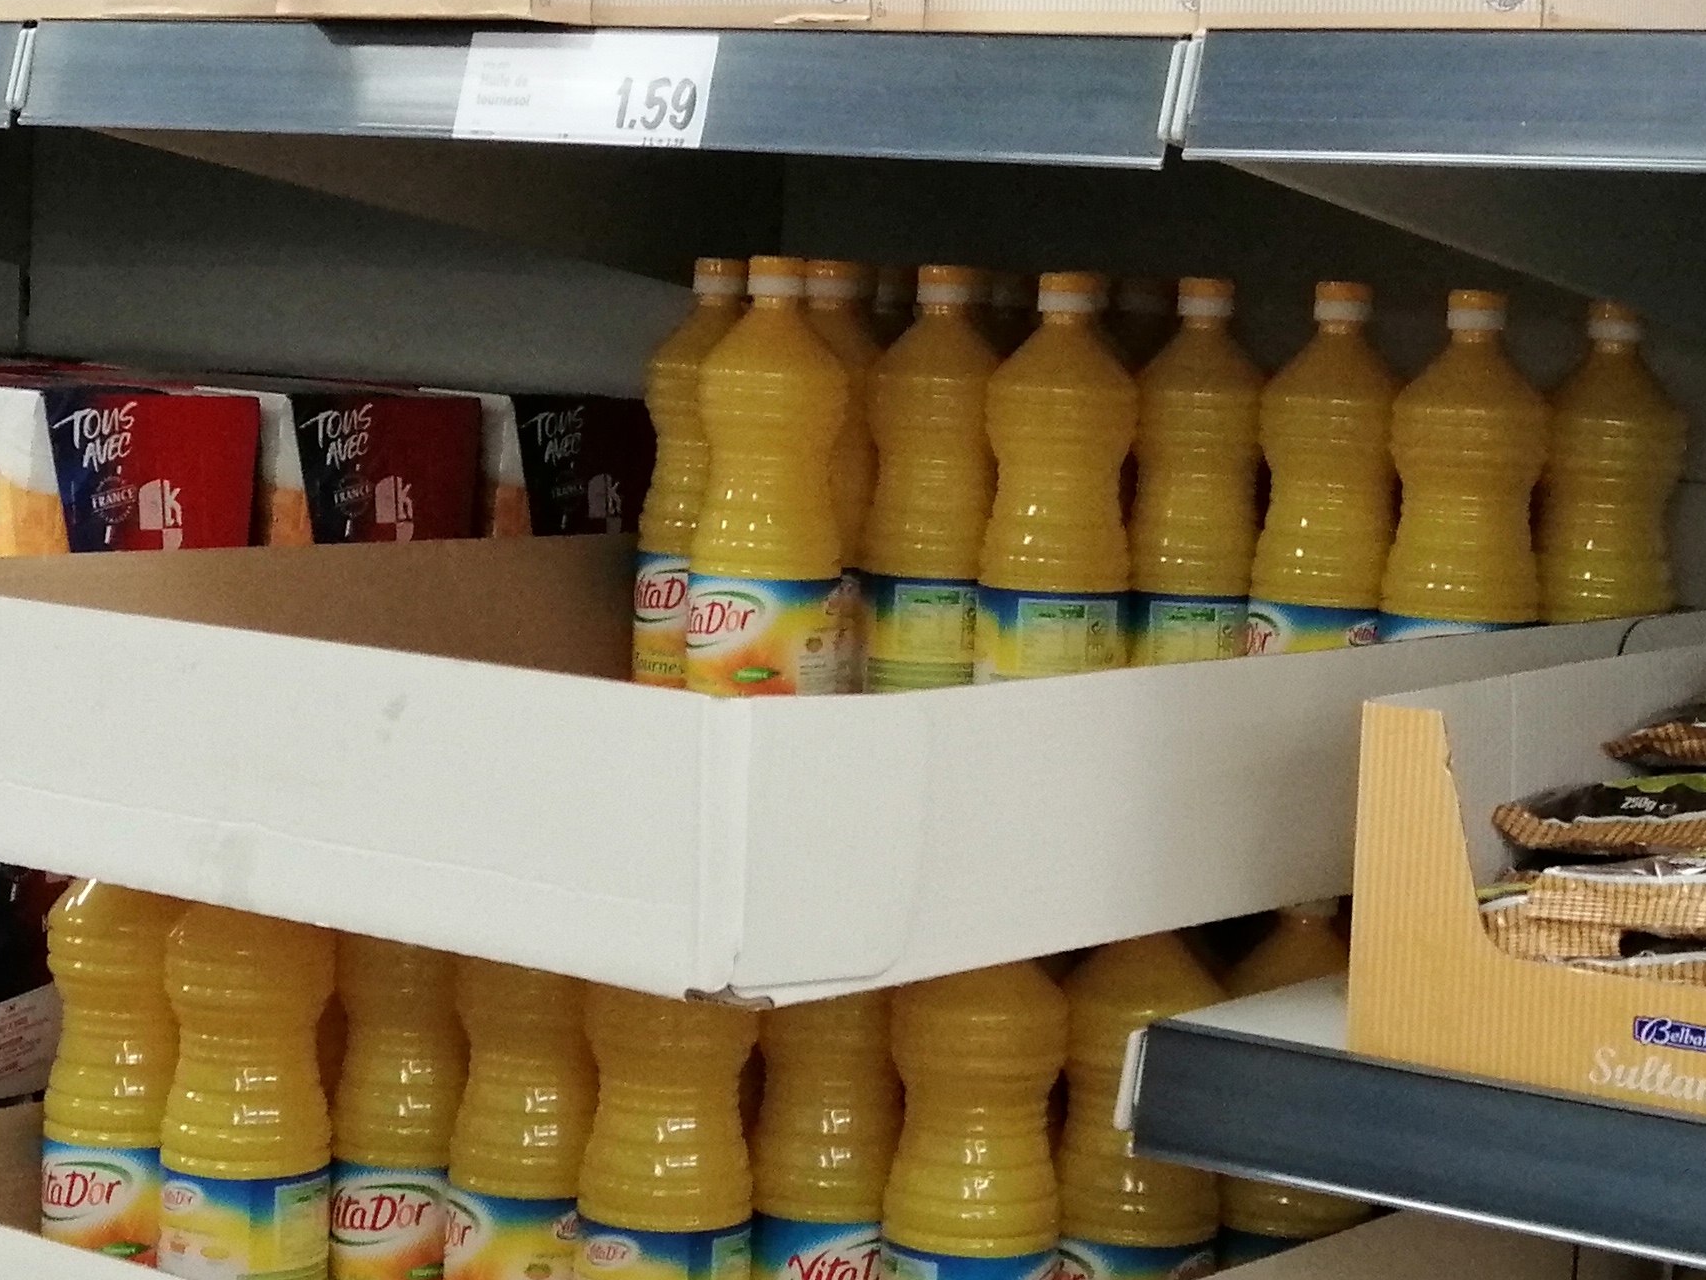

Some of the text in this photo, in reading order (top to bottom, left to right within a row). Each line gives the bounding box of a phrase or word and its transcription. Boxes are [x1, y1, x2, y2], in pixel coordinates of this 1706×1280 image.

[616, 77, 697, 130] 1.59
[52, 402, 137, 448] TOUS
[299, 404, 372, 451] TOUS
[82, 433, 131, 472] AVEC
[1620, 794, 1659, 815] 250g
